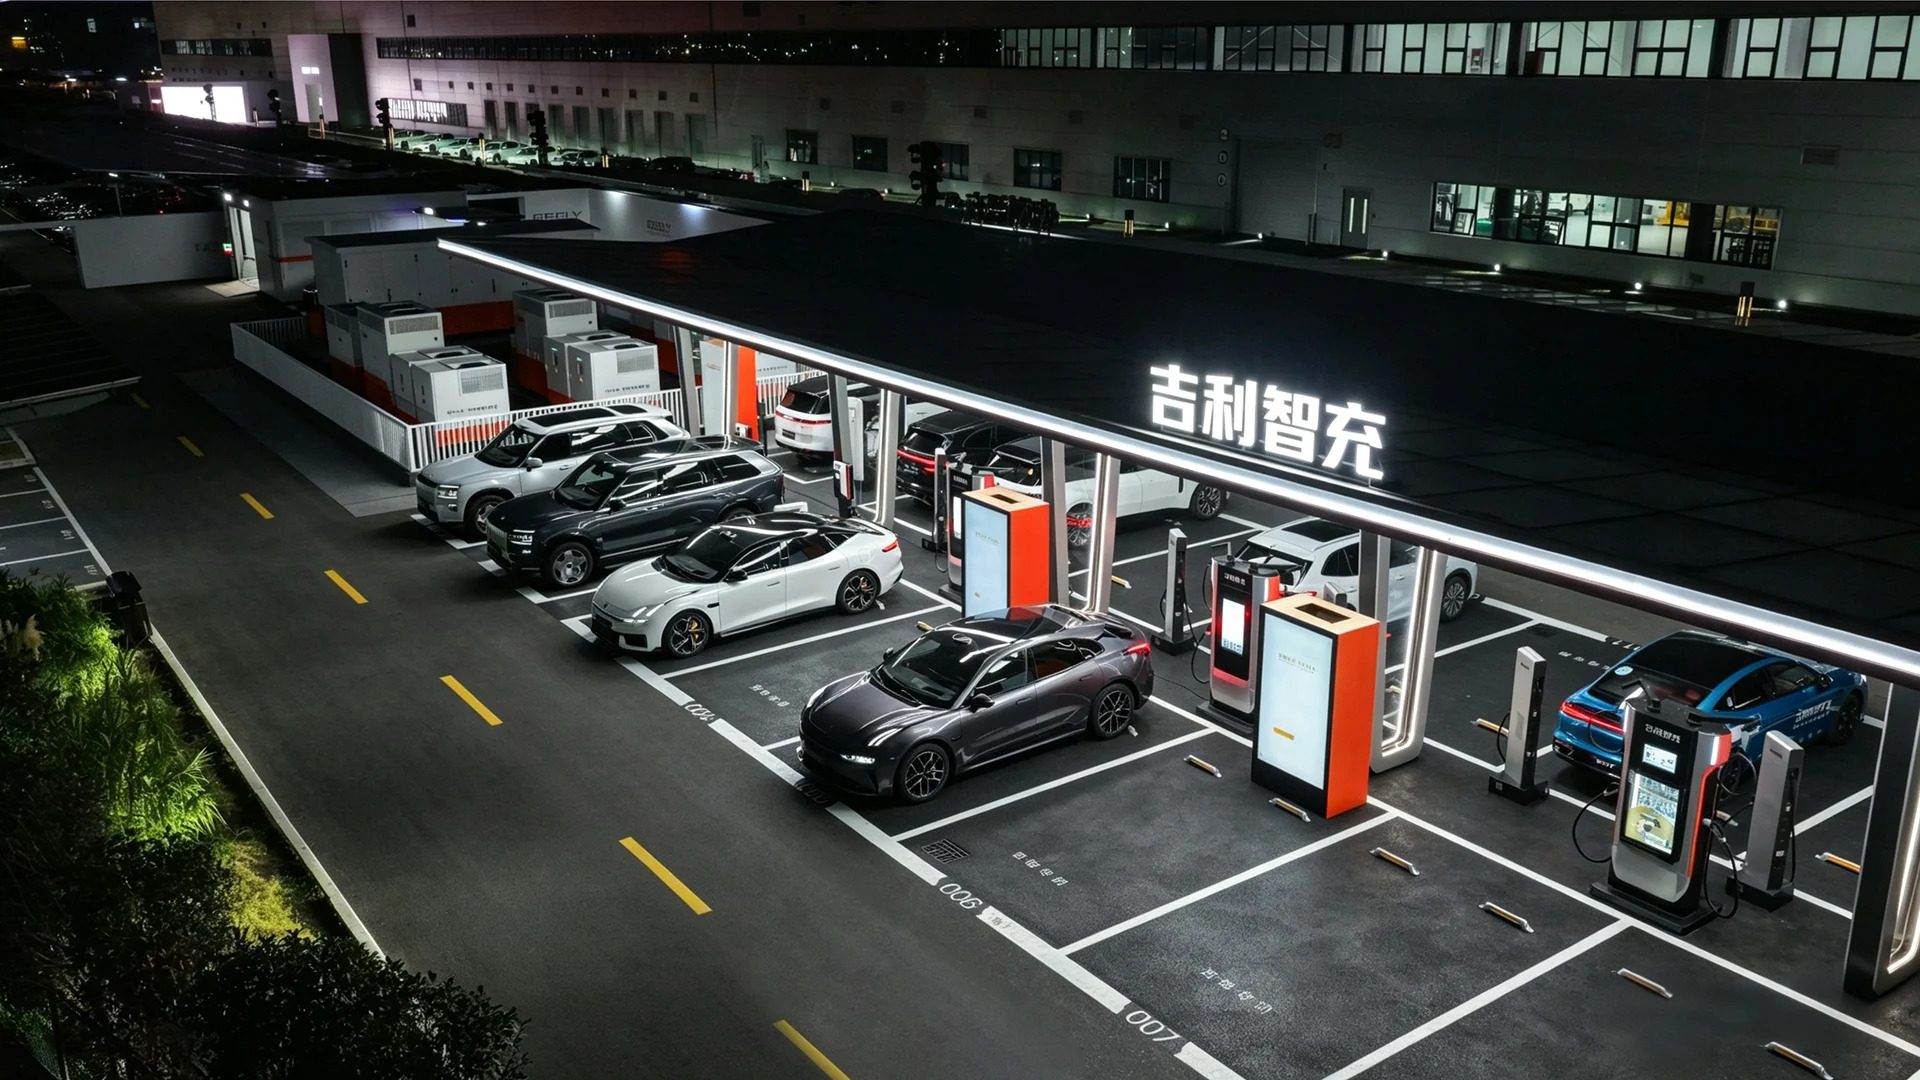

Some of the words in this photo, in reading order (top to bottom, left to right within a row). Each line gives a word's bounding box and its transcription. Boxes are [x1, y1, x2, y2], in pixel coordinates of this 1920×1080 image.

[1150, 362, 1386, 480] 吉利智充
[939, 883, 983, 909] 006
[1125, 1010, 1182, 1041] 007
